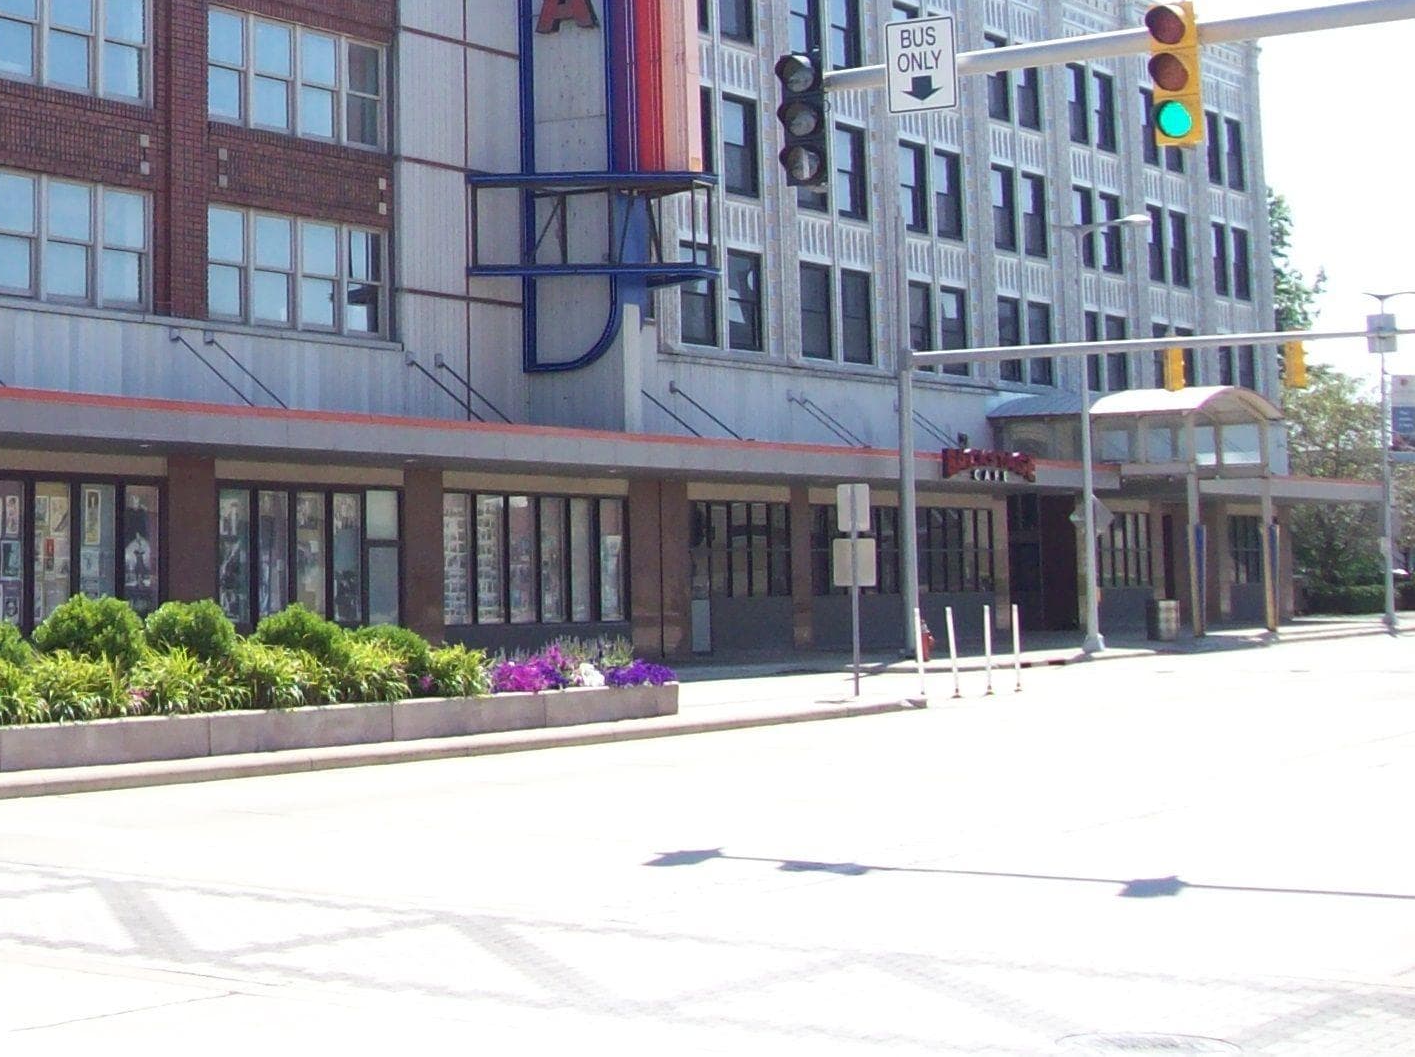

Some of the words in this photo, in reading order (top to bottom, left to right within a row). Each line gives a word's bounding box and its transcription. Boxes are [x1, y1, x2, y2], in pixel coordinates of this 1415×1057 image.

[900, 26, 937, 49] BUS
[897, 49, 942, 73] ONLY
[972, 468, 1009, 482] CAFE
